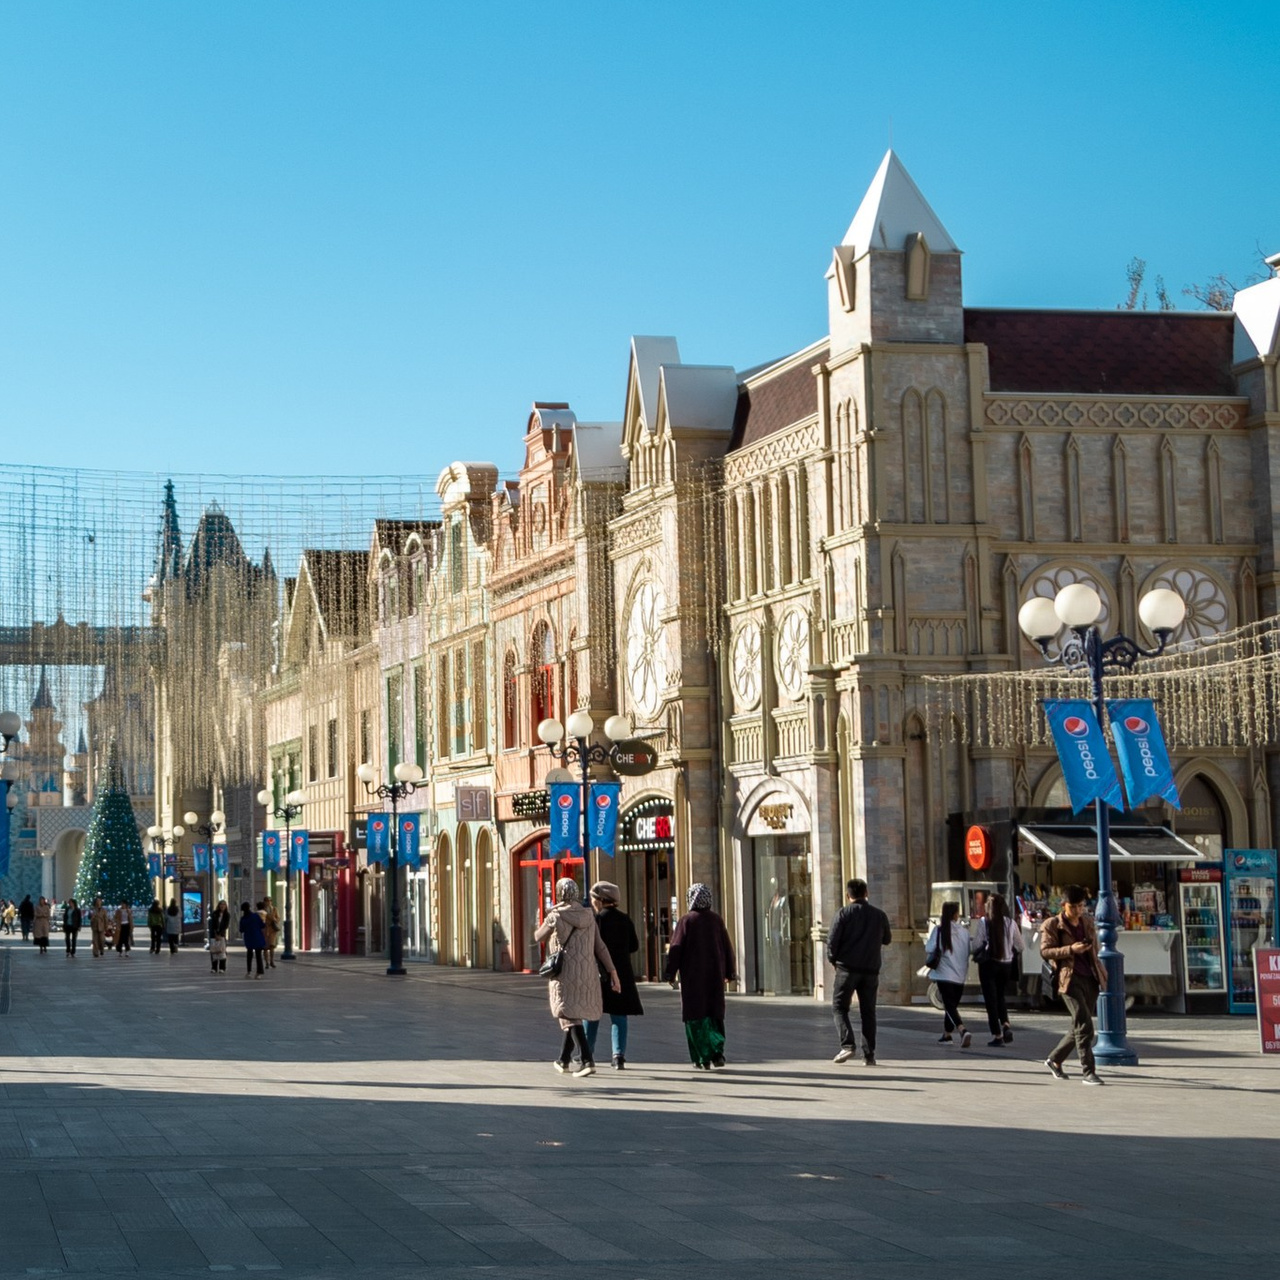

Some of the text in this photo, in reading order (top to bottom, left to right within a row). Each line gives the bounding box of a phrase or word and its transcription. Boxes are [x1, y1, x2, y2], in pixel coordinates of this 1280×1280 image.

[1075, 739, 1100, 780] pepsi
[1135, 737, 1159, 776] pepsi
[636, 815, 675, 839] CHERRY
